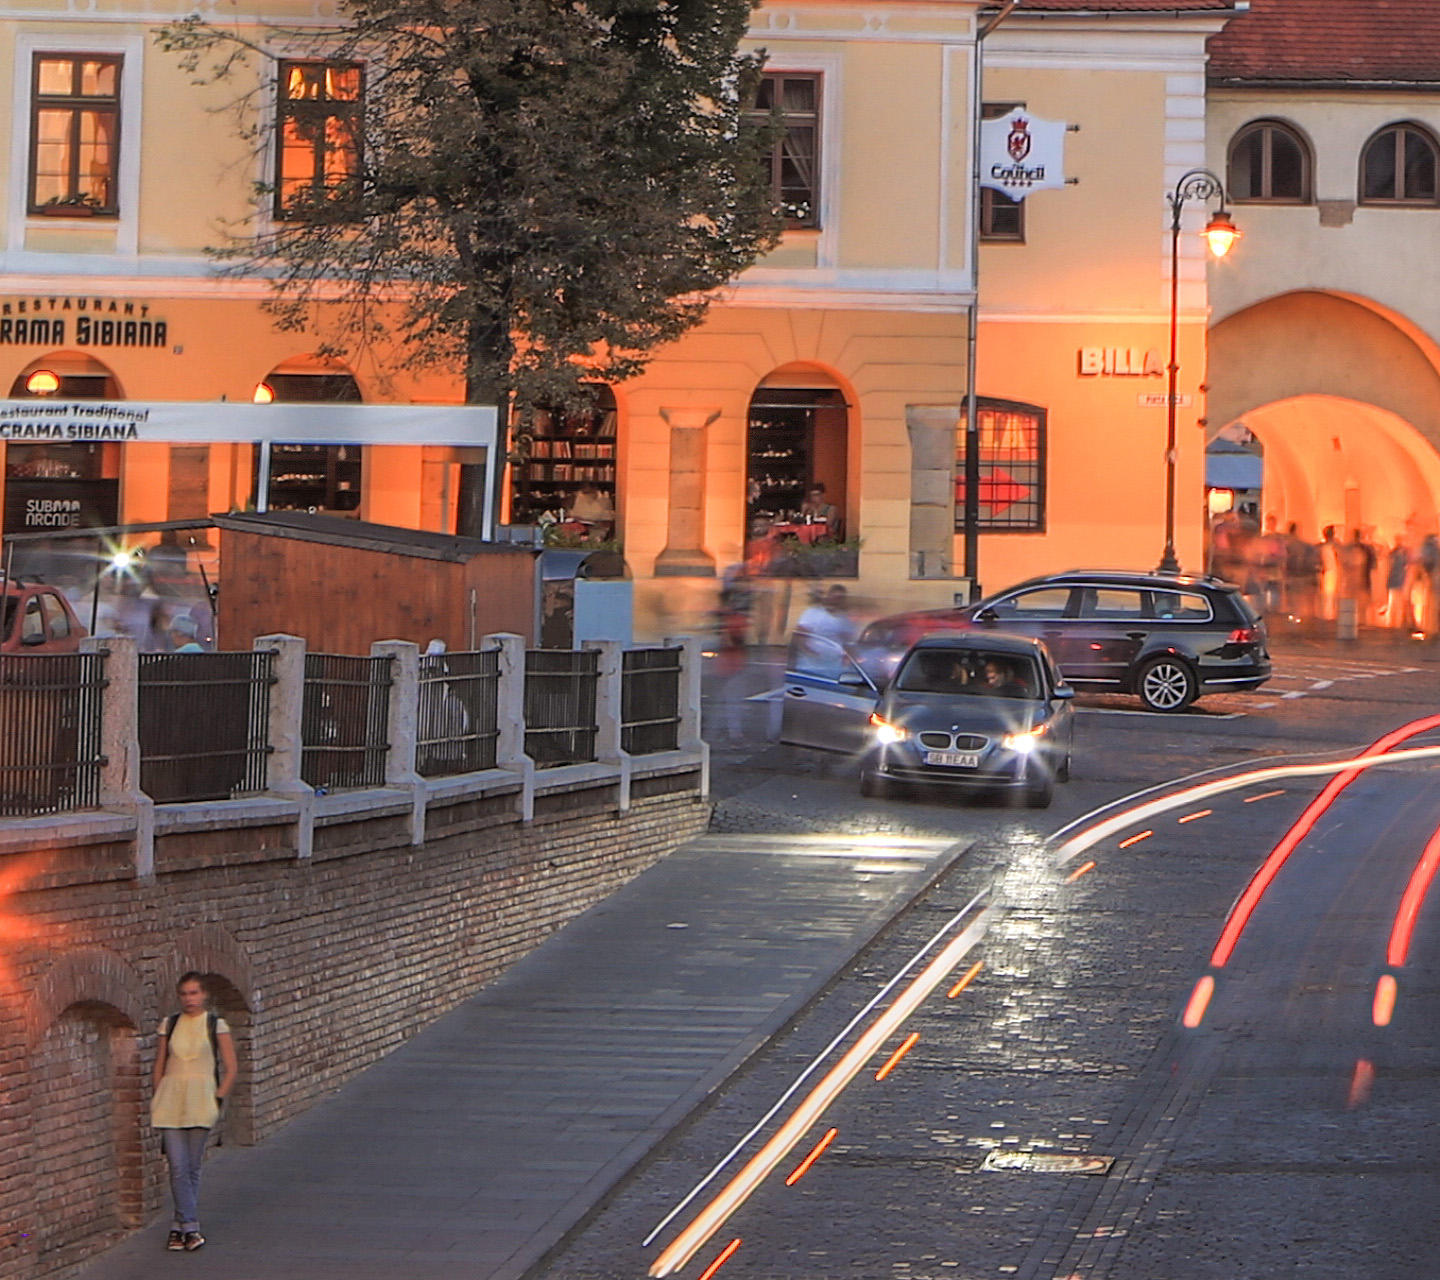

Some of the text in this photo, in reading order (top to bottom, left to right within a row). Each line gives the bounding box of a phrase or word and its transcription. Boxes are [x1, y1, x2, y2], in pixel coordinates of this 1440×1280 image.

[2, 298, 149, 317] RESTAURANT
[1078, 346, 1164, 378] BILLA
[0, 423, 62, 439] CRAMA
